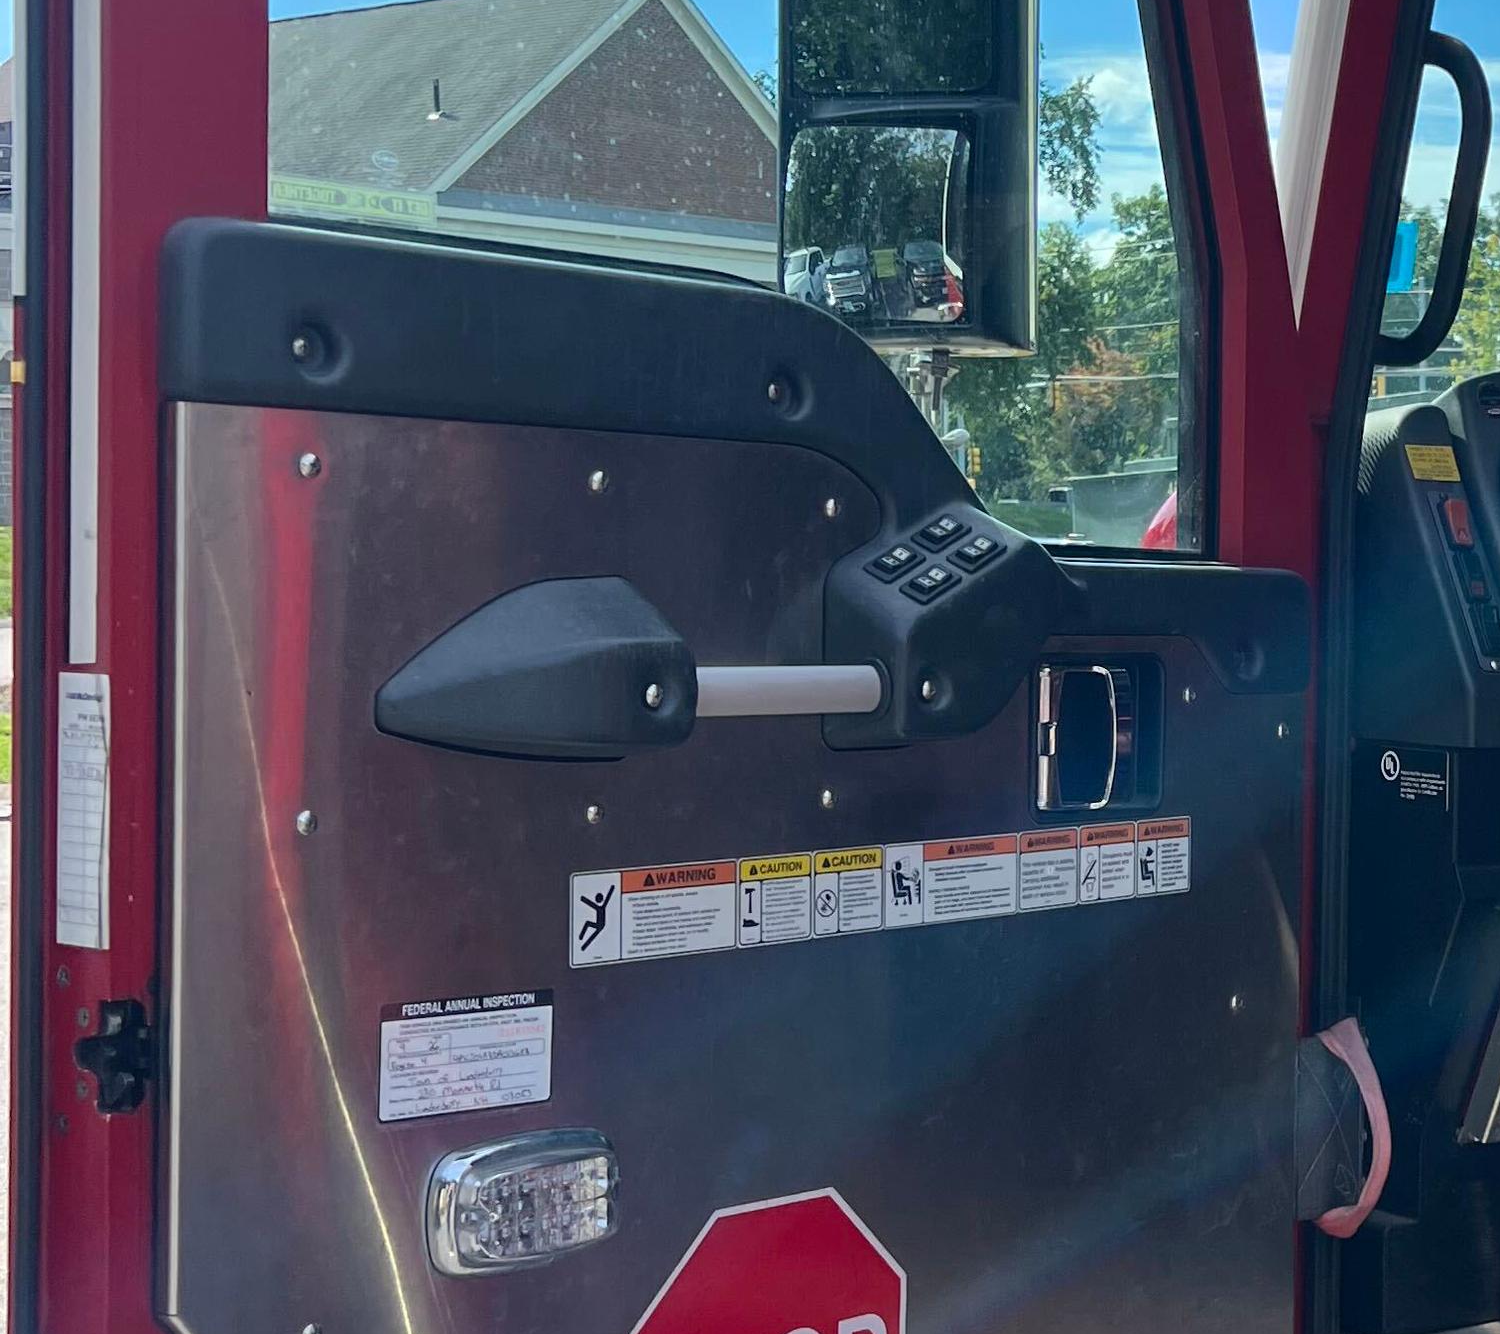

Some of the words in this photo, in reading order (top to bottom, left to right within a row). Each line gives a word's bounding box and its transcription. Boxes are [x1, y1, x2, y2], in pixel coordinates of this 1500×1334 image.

[760, 861, 803, 874] CAUTION
[832, 853, 877, 867] CAUTION
[655, 867, 717, 885] WARNING
[402, 1001, 443, 1017] FEDERAL
[445, 998, 481, 1013] ANNUAL
[482, 992, 536, 1009] INSPECTION
